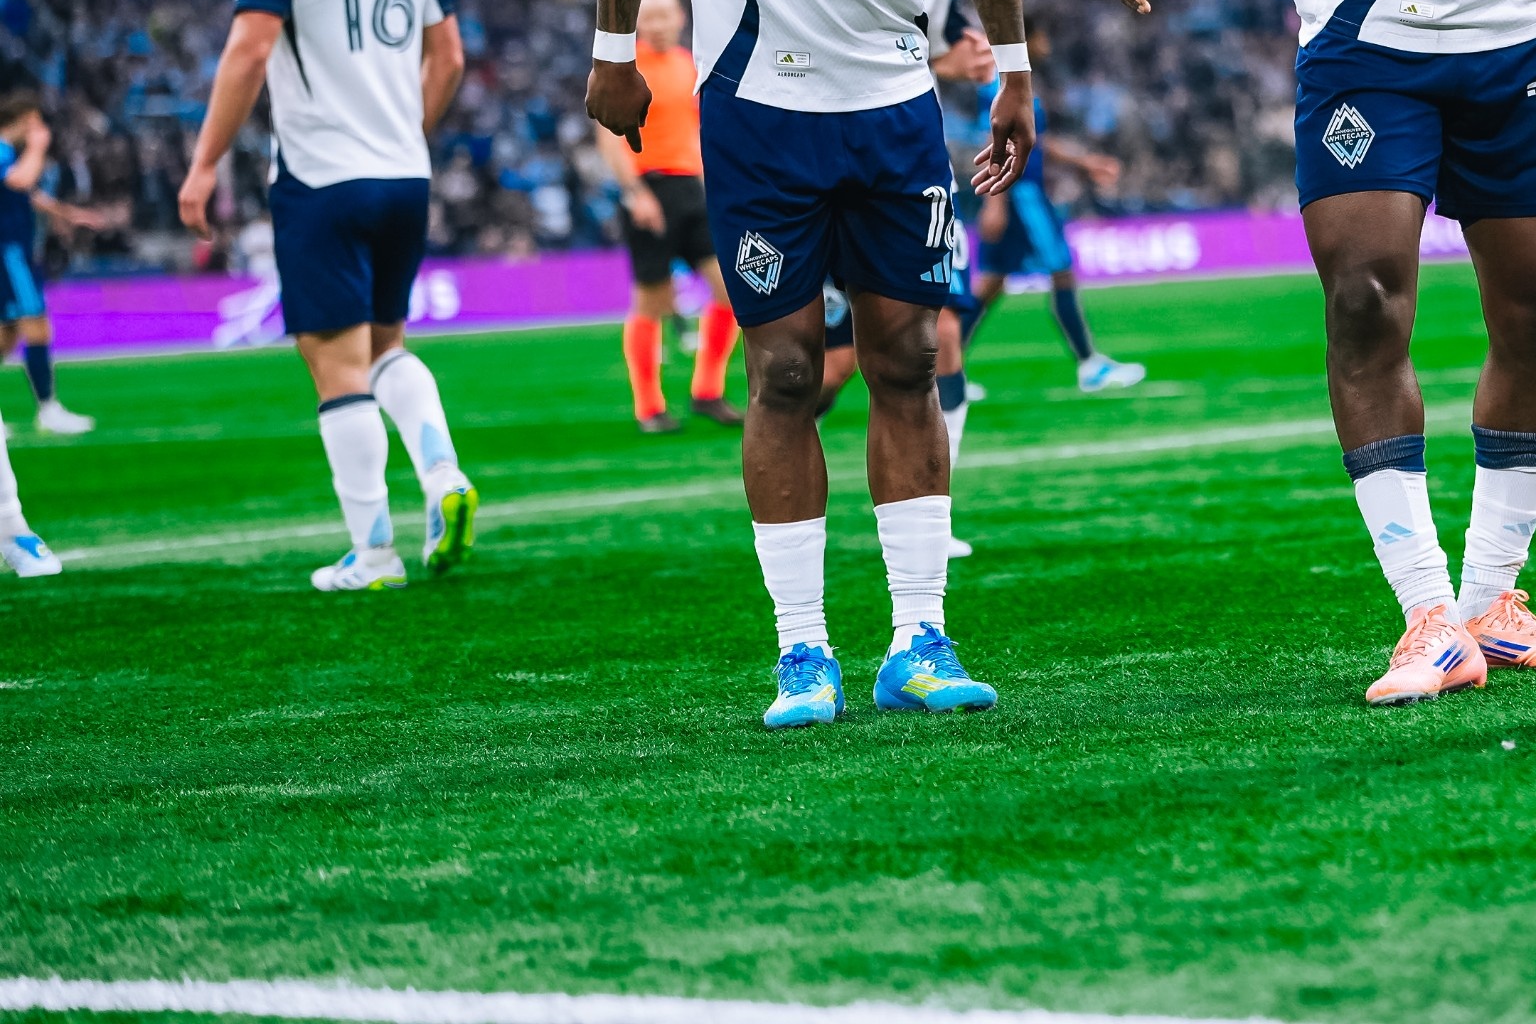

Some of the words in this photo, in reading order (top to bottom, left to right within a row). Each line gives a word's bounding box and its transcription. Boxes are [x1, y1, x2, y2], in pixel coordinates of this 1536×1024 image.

[1327, 131, 1370, 143] WHITECAPS
[1344, 139, 1354, 147] FC
[739, 254, 779, 272] WHITECAPS
[755, 266, 765, 274] FC
